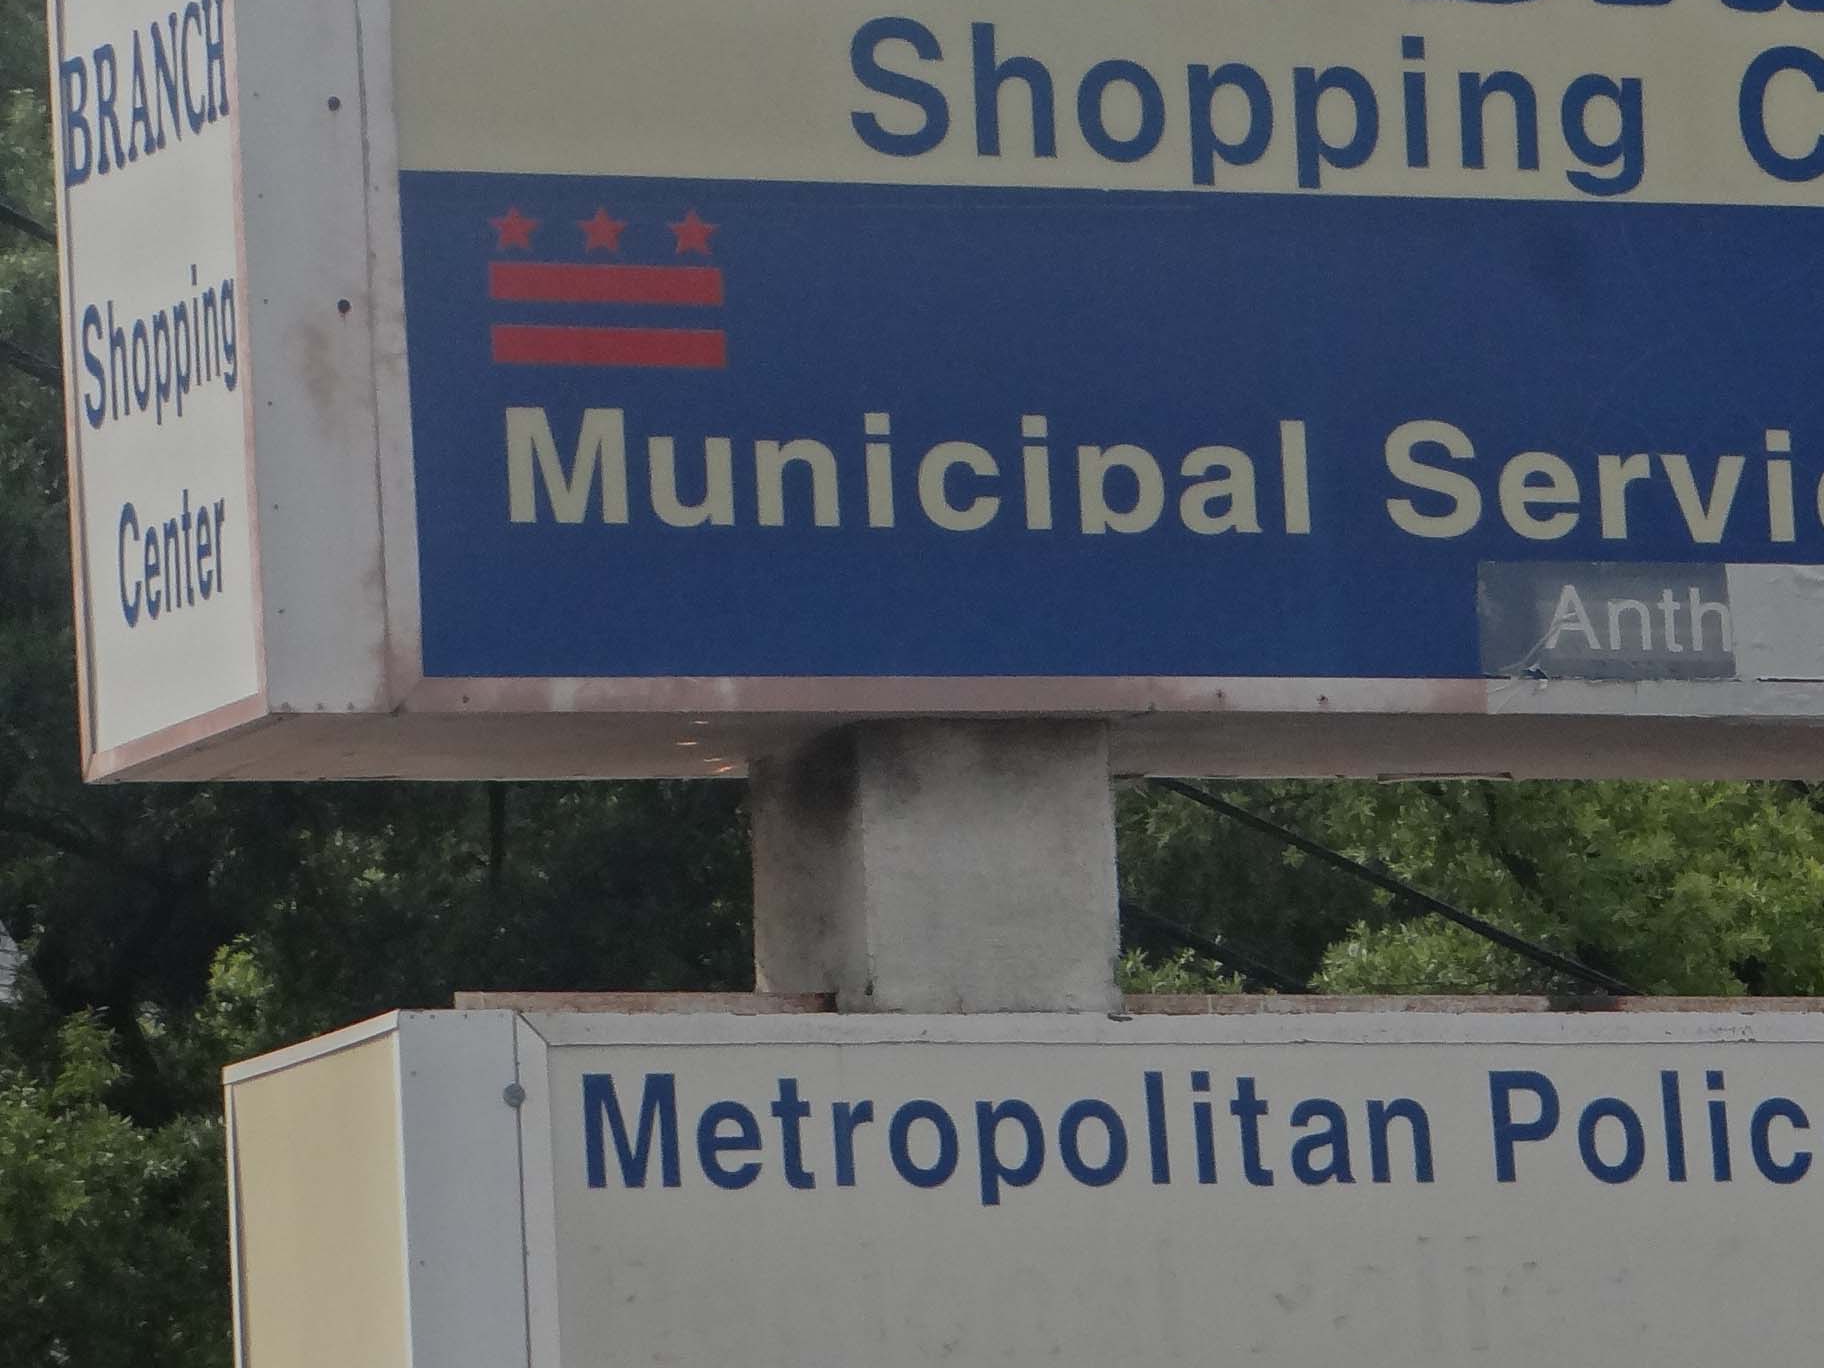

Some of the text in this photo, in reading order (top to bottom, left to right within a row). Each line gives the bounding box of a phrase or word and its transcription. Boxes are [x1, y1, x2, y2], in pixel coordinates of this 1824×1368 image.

[850, 16, 1645, 195] Shopping
[81, 265, 238, 429] Shopping
[504, 406, 1310, 536] Municipal
[117, 489, 226, 628] Center
[582, 1069, 1433, 1205] Metropolitan
